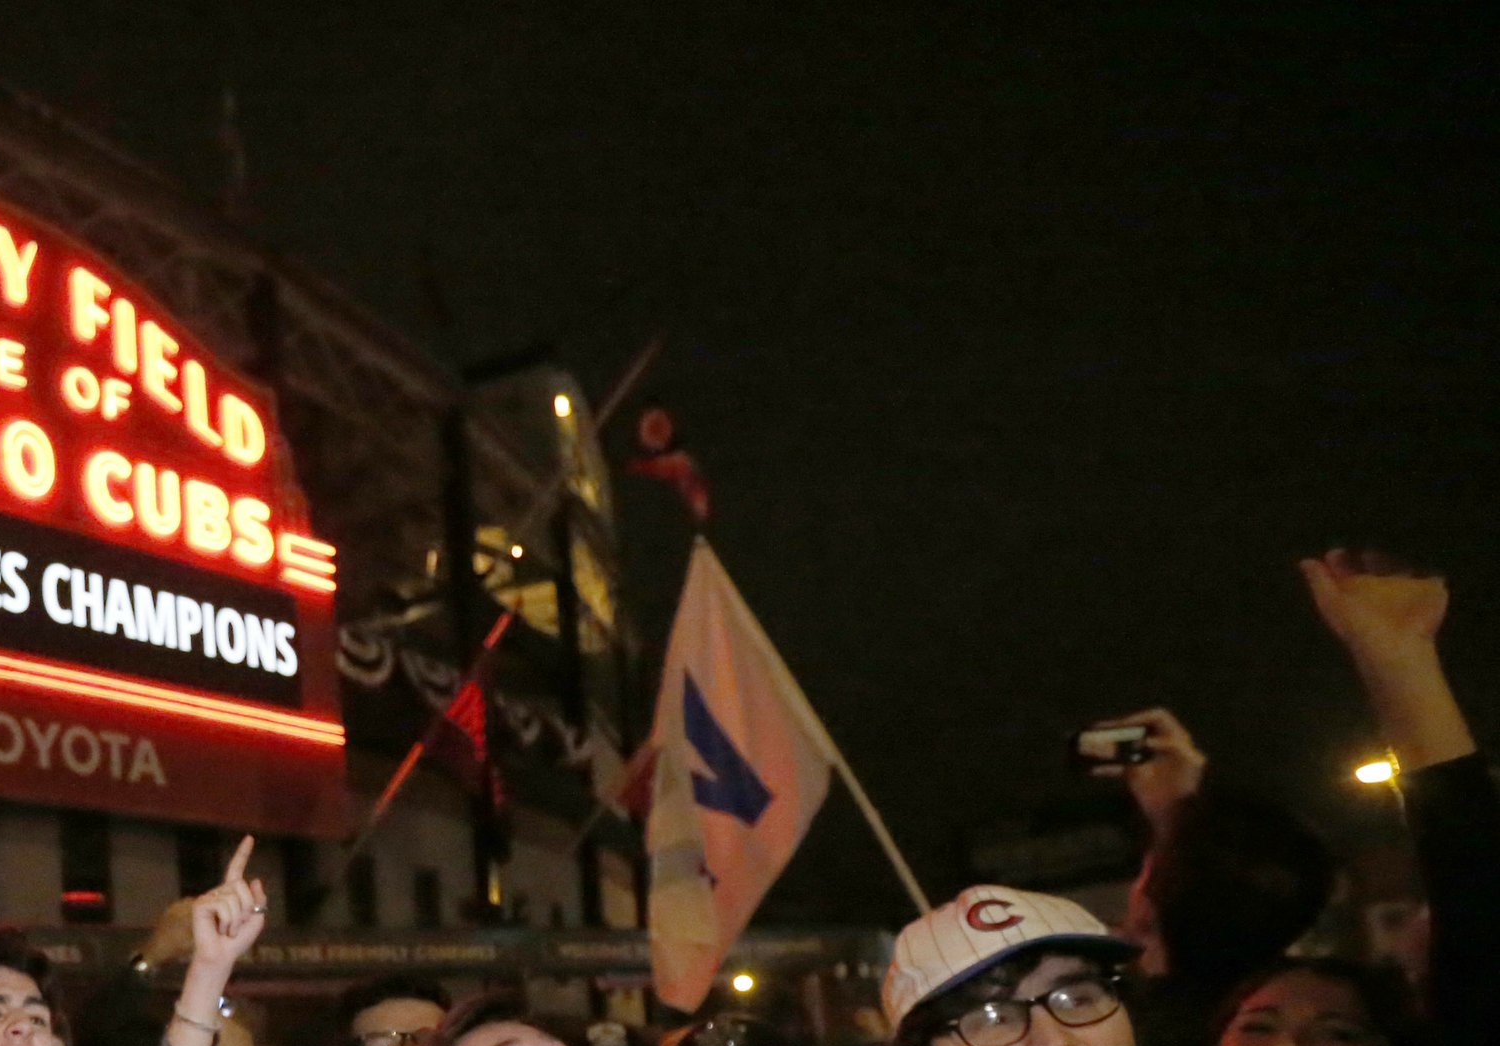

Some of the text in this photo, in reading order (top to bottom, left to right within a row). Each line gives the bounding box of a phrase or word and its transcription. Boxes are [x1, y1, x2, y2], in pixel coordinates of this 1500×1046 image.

[60, 366, 133, 421] OF
[68, 266, 267, 465] FIELD
[84, 450, 276, 565] CUBS
[41, 561, 299, 677] CHAMPIONS
[967, 899, 1024, 931] C
